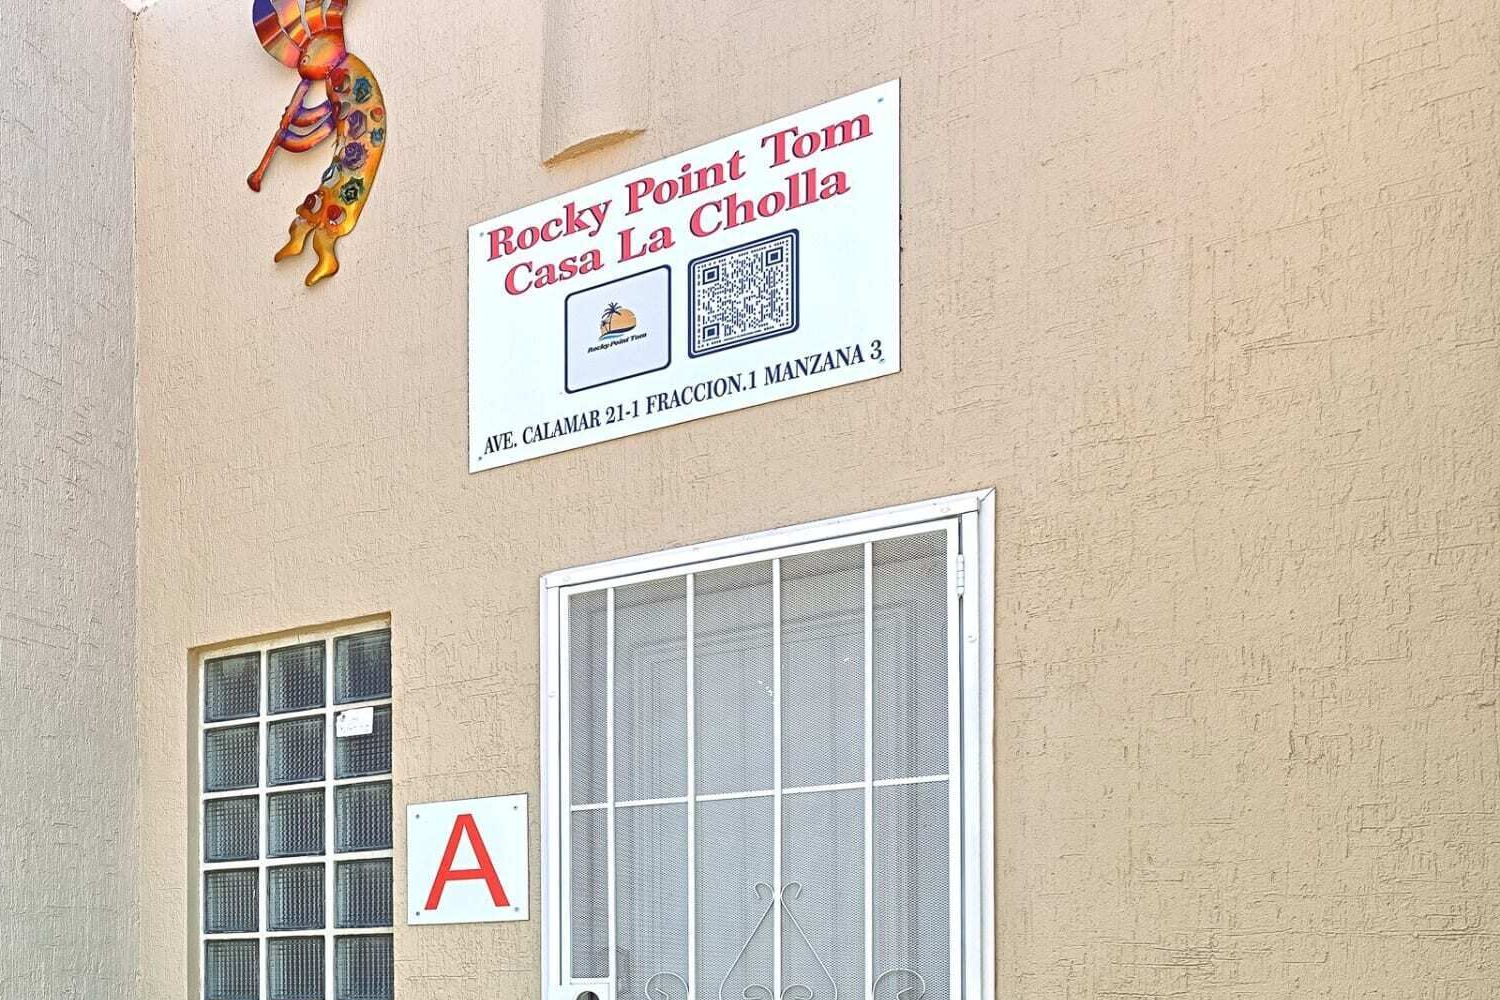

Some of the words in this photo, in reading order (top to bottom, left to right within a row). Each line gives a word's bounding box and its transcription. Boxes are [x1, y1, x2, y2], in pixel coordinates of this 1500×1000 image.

[486, 198, 613, 263] Rocky
[624, 150, 747, 217] Point
[761, 112, 874, 169] Tom
[504, 244, 605, 297] Casa
[617, 221, 676, 264] La
[688, 167, 852, 238] Cholla
[483, 431, 518, 455] AVE.
[522, 409, 602, 445] CALAMAR
[605, 400, 640, 425] 21-1
[763, 343, 866, 386] MANZANA
[870, 339, 883, 360] 3
[587, 343, 609, 354] Rocky
[609, 336, 630, 347] Point
[424, 813, 511, 911] A
